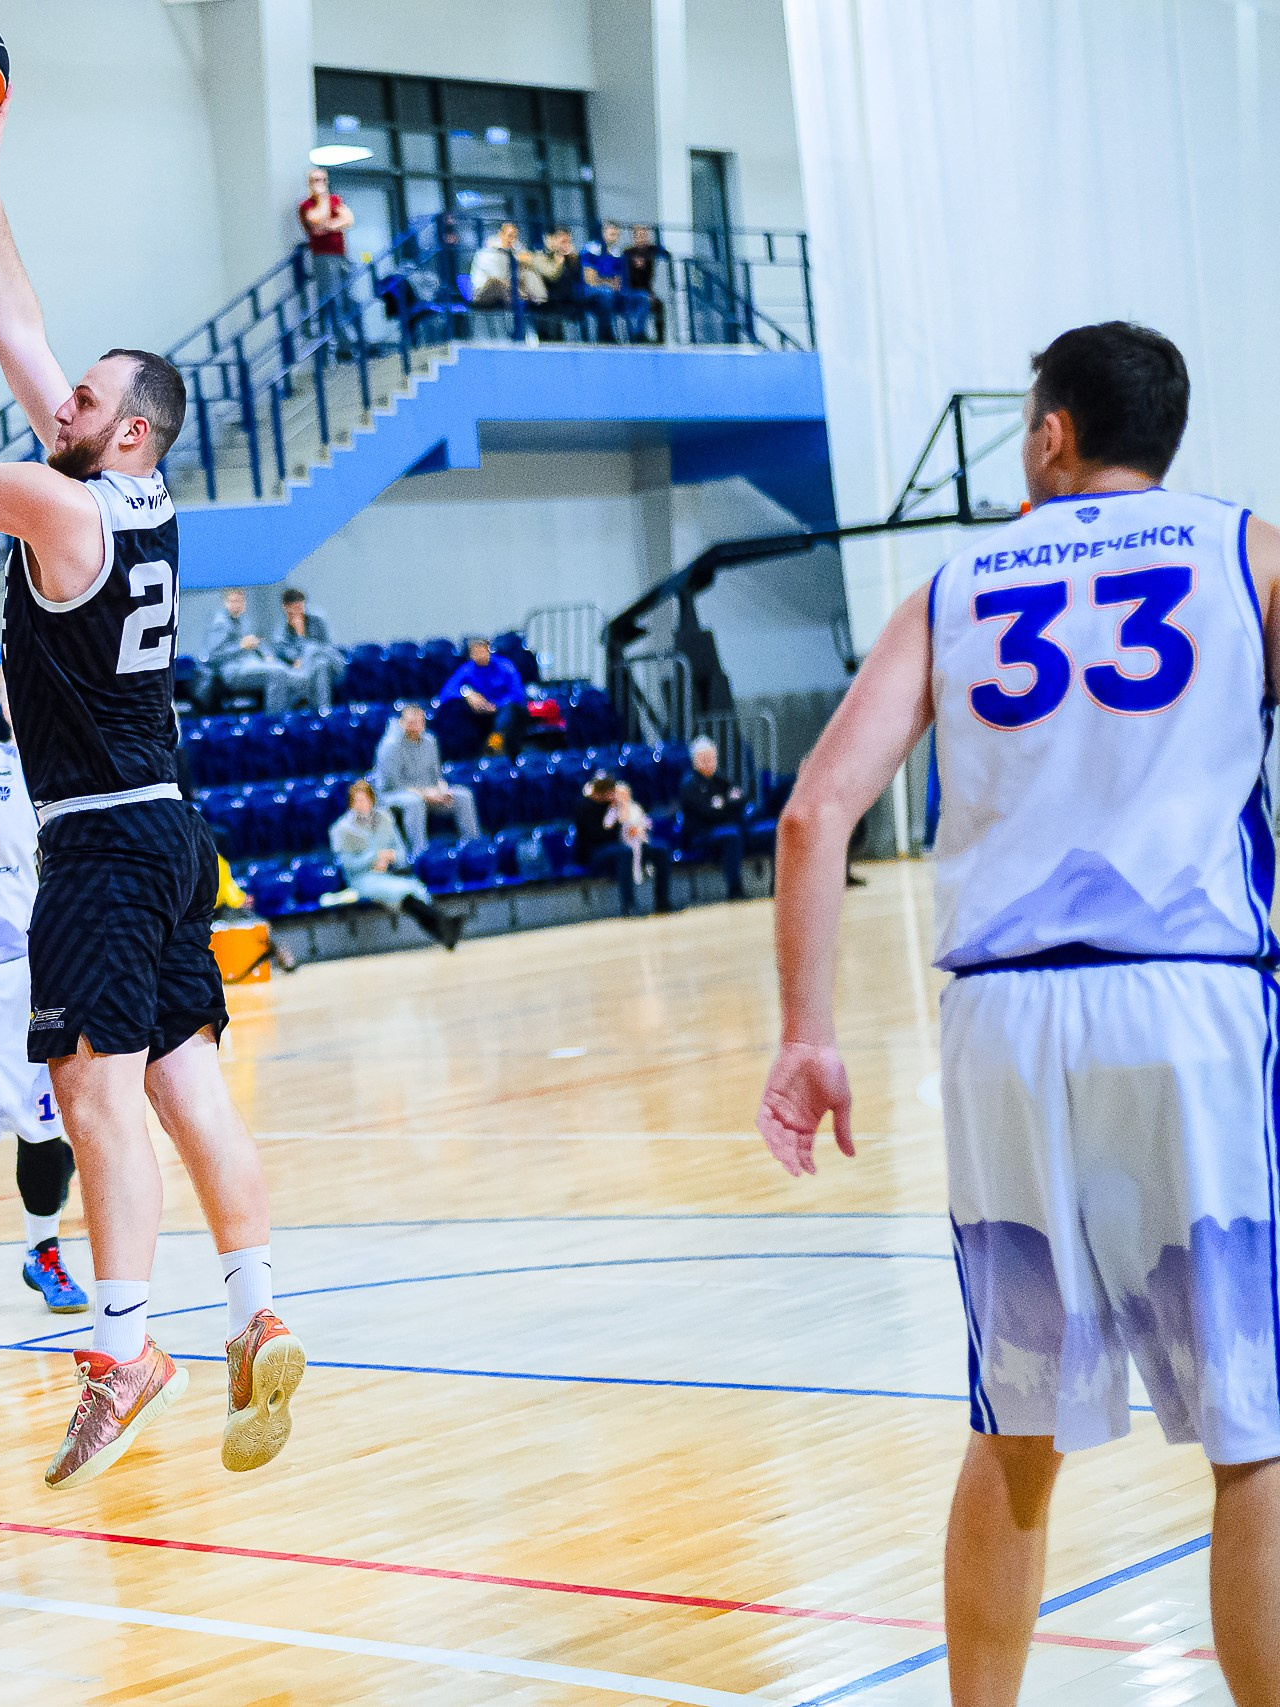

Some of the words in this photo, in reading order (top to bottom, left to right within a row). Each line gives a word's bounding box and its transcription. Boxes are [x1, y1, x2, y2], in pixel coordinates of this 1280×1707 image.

[973, 525, 1196, 577] МЕЖДУРЕЧЕНСК
[116, 559, 180, 675] 2
[966, 561, 1200, 732] 33
[36, 1090, 62, 1123] 1
